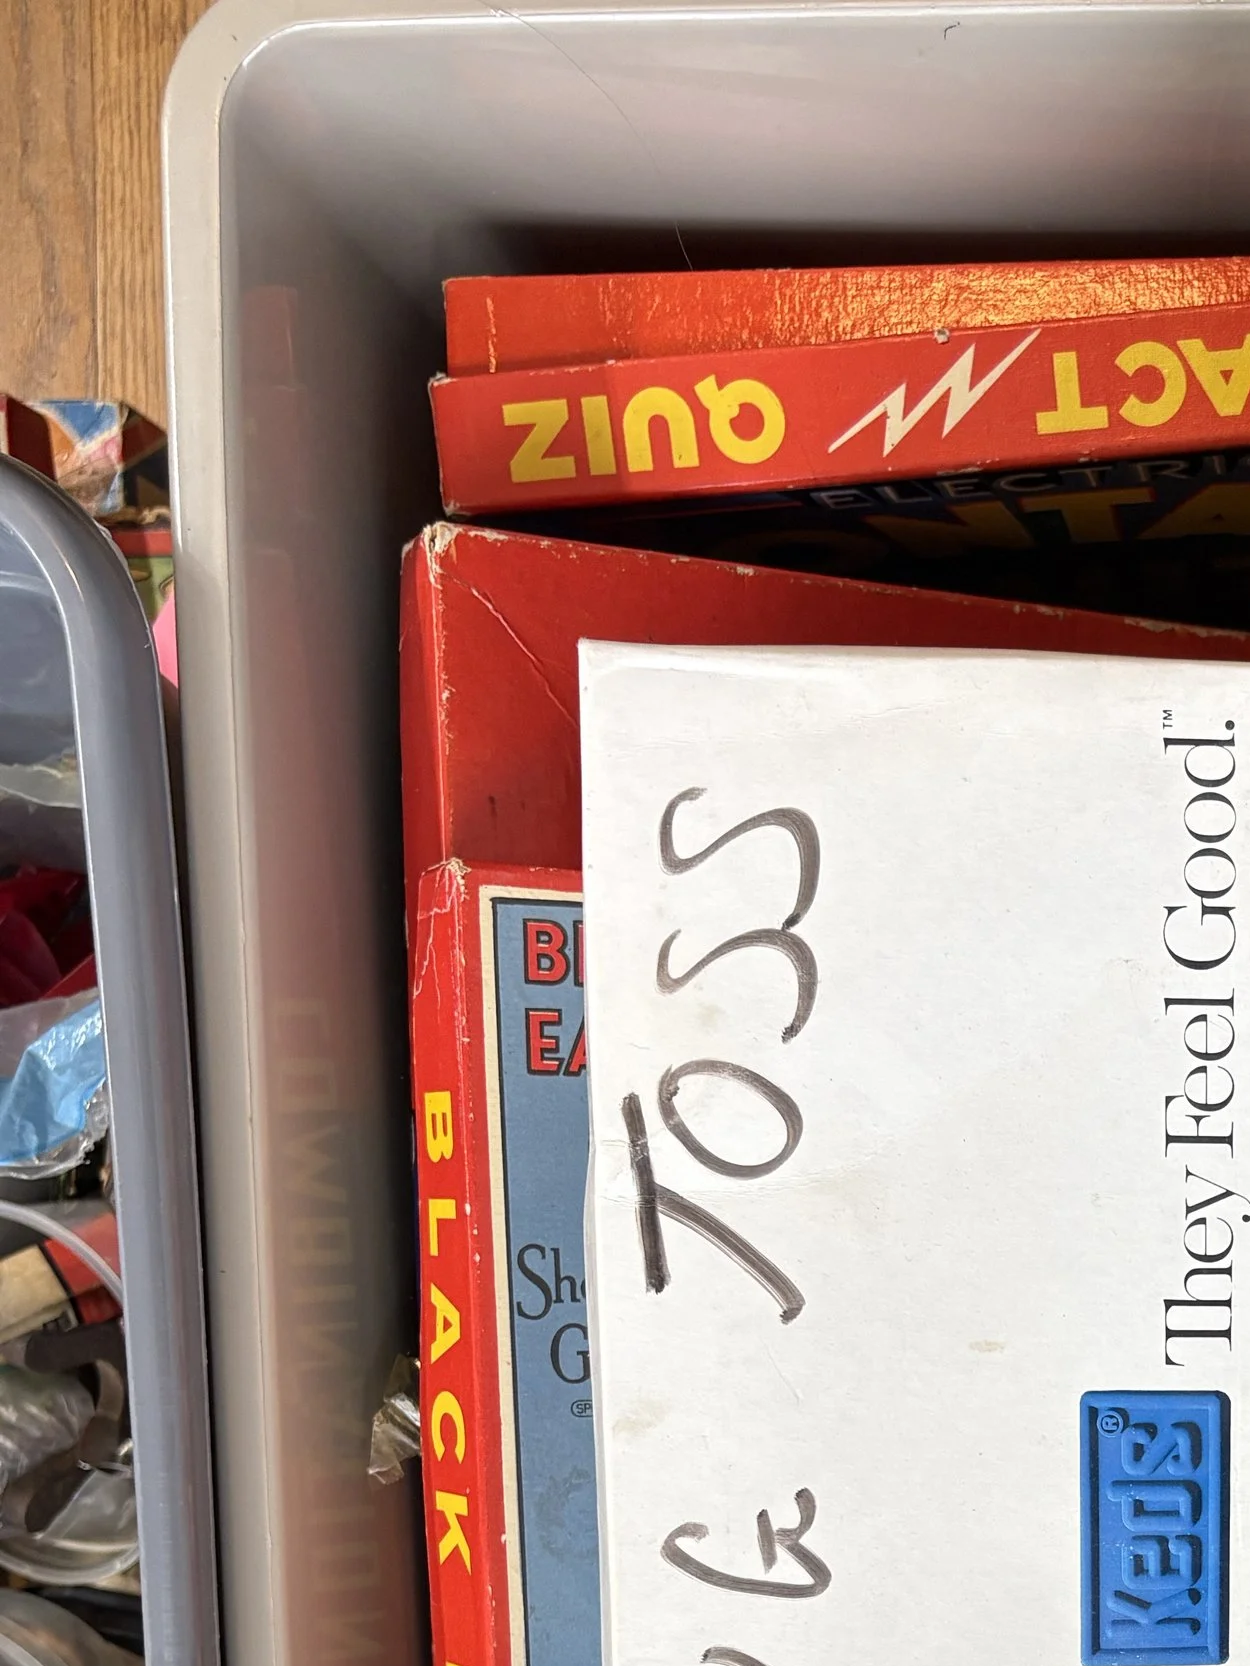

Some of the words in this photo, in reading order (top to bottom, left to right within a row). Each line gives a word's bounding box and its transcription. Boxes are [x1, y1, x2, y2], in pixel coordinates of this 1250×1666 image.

[503, 374, 785, 483] QUIZ
[1164, 718, 1236, 970] Good.
[621, 786, 820, 1324] TOSS
[1166, 987, 1235, 1158] Feel
[421, 1090, 476, 1580] BLACK
